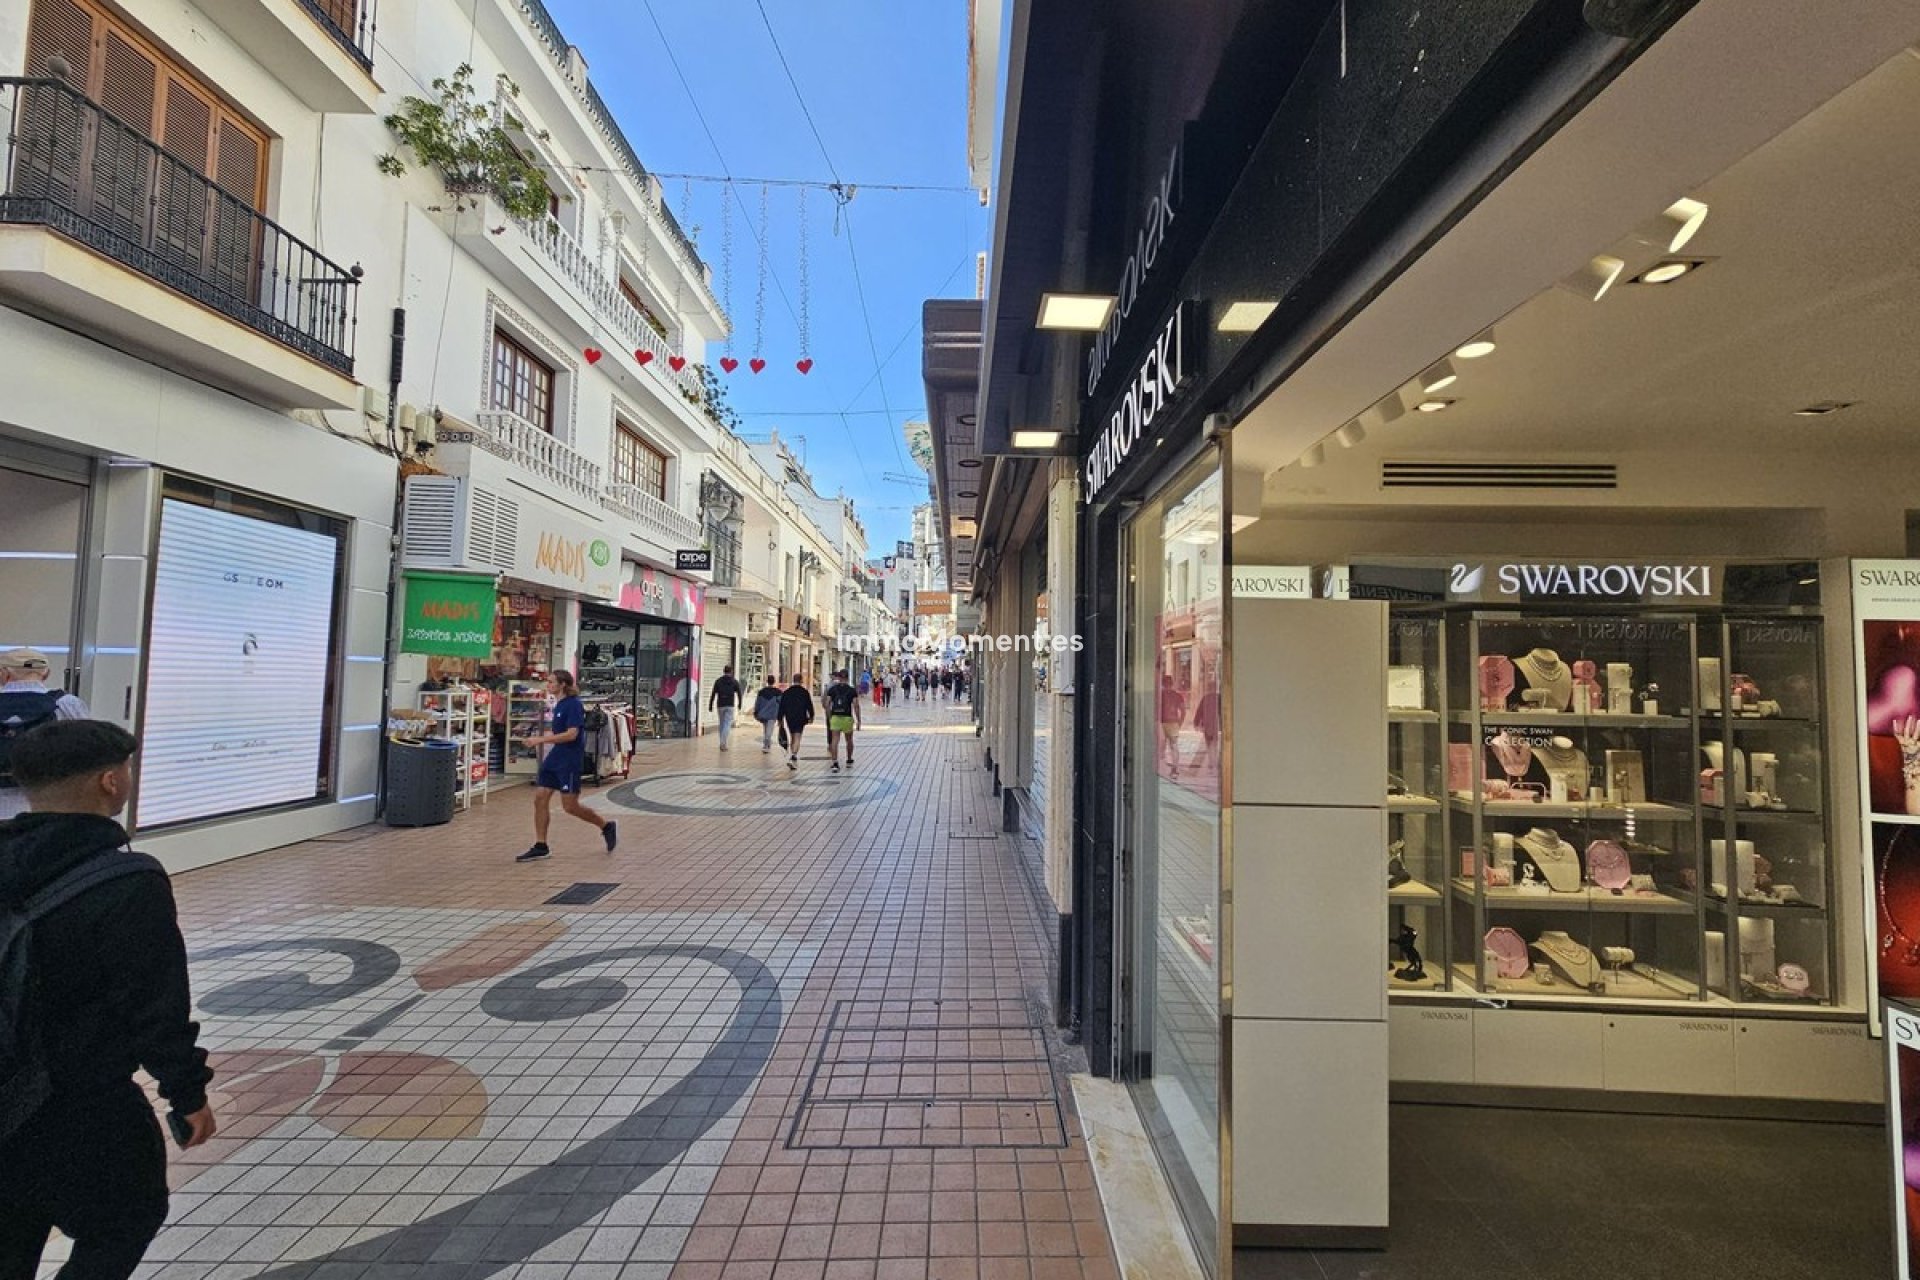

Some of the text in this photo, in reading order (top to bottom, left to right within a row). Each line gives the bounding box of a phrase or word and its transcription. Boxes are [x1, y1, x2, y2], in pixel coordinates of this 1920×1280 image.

[1086, 301, 1183, 505] SWAROVSKI
[535, 531, 586, 583] MADIS
[679, 553, 708, 564] arpe
[1498, 564, 1712, 597] SWAROVSKI
[1860, 569, 1920, 587] SWAR
